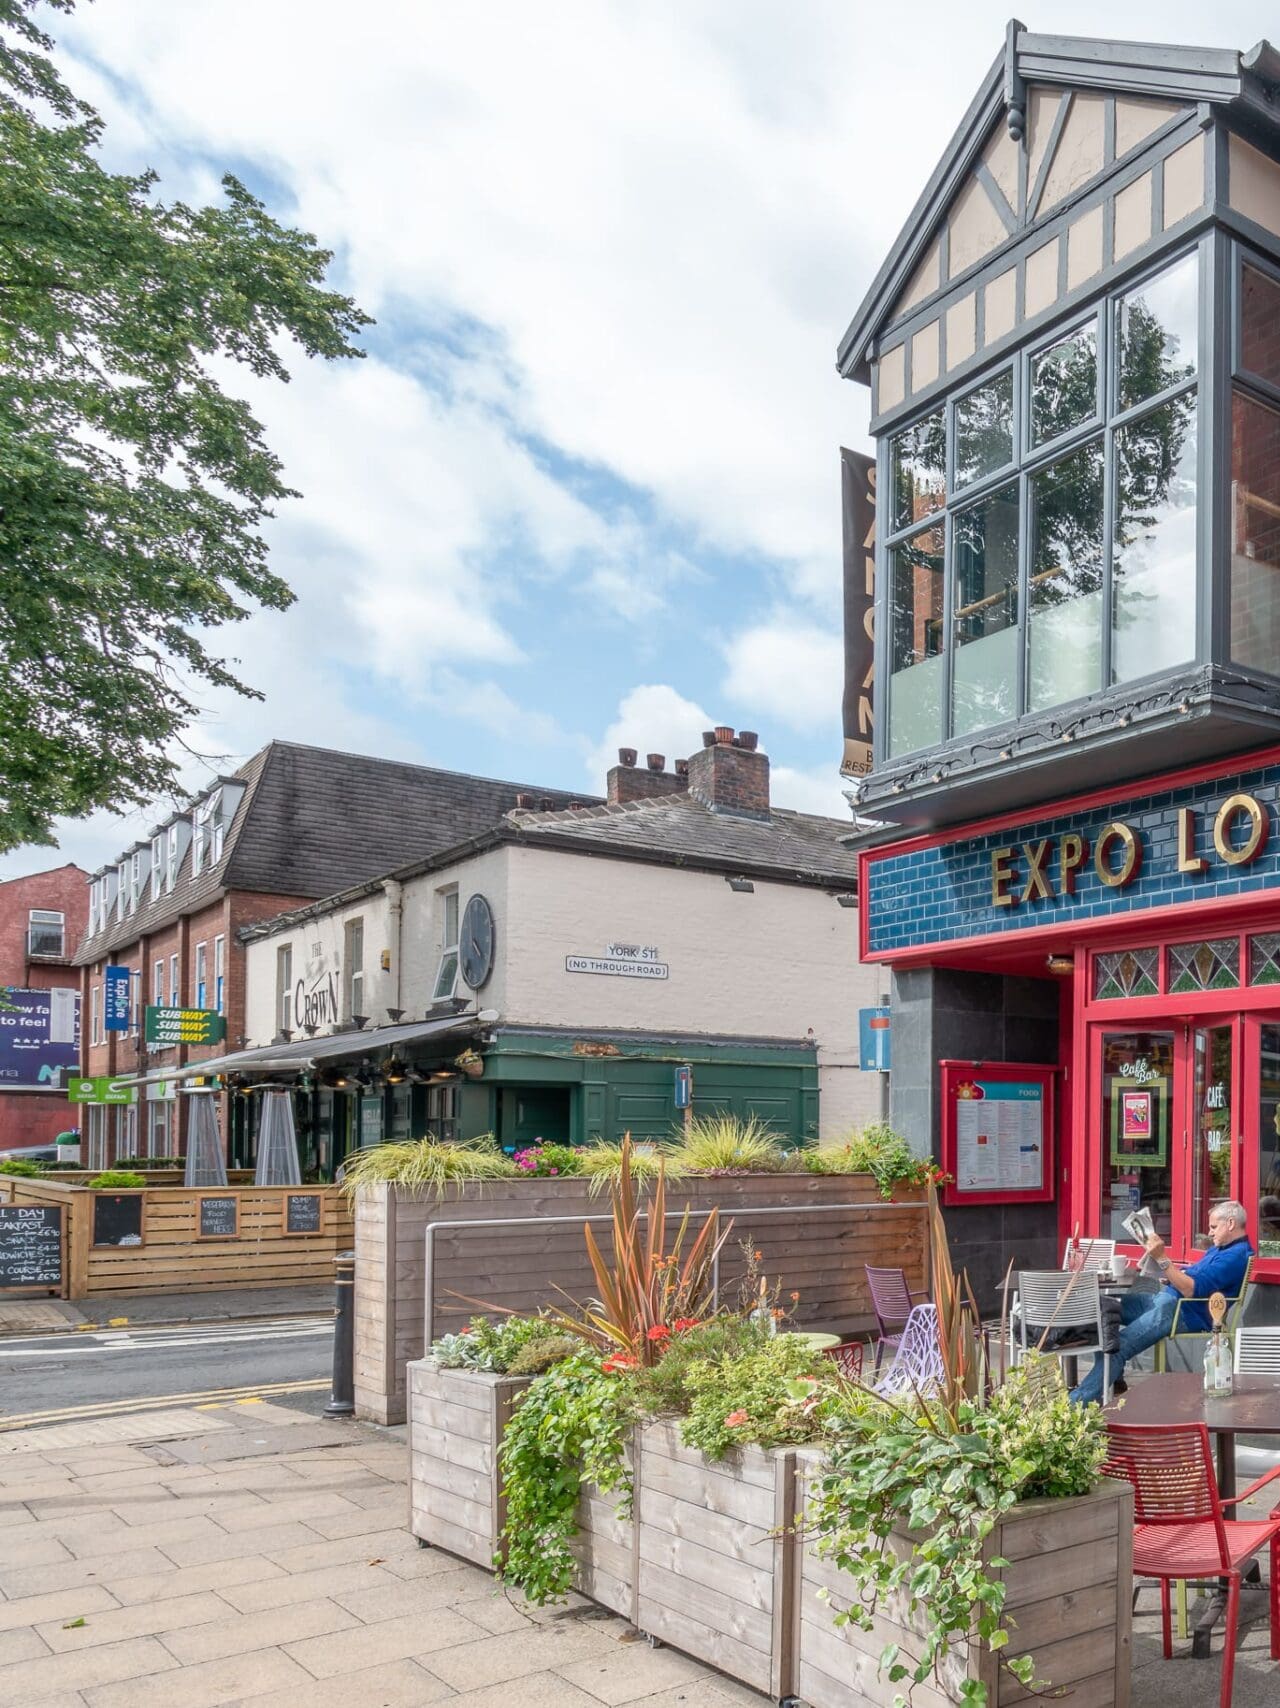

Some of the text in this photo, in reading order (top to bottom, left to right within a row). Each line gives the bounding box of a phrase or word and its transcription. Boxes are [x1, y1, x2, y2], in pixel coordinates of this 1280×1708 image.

[990, 821, 1142, 907] EXPO
[609, 945, 638, 957] YORK
[568, 959, 666, 976] (NO THROUGH ROAD)
[115, 979, 129, 1018] Explore
[295, 971, 340, 1028] CROWN
[1, 1016, 46, 1027] to feel
[156, 1009, 211, 1020] SUBWAY
[155, 1020, 210, 1031] SUBWAY
[155, 1031, 210, 1042] SUBWAY
[1119, 1058, 1148, 1079] Café
[1136, 1070, 1160, 1085] Bar
[1207, 1082, 1224, 1108] CAFÉ
[1207, 1131, 1221, 1152] BAR
[18, 1209, 45, 1219] DAY
[7, 1266, 42, 1274] COURSE
